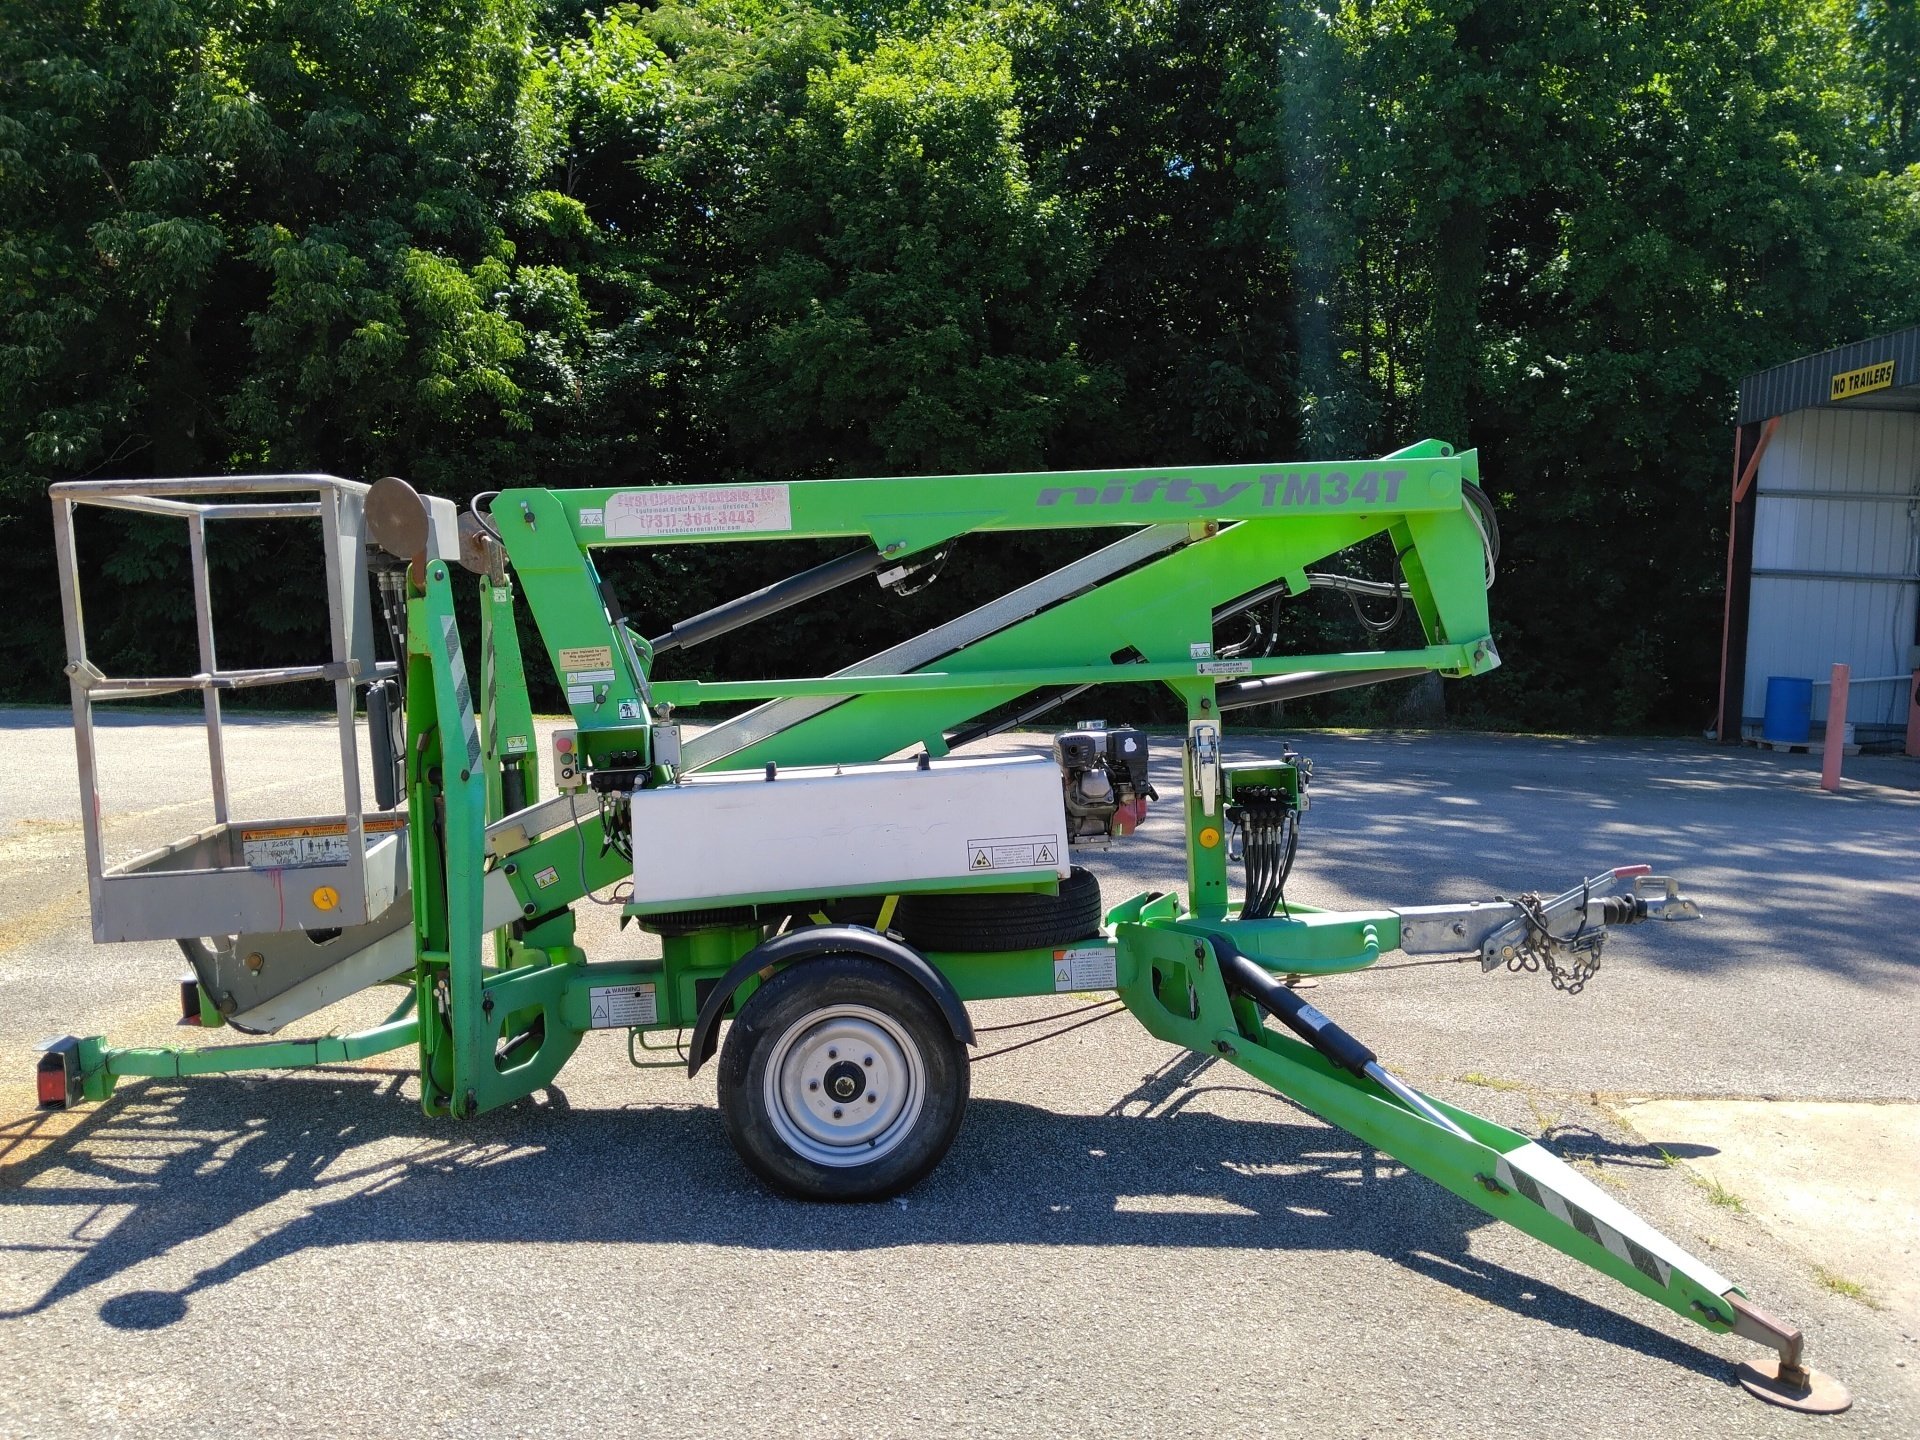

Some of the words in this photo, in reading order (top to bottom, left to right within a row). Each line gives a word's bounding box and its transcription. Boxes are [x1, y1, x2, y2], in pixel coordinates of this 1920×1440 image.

[1833, 378, 1845, 394] NO
[1849, 366, 1892, 390] TRAILERS
[1036, 477, 1257, 508] nifty
[1259, 471, 1407, 507] TM34T
[611, 986, 641, 994] WARNING
